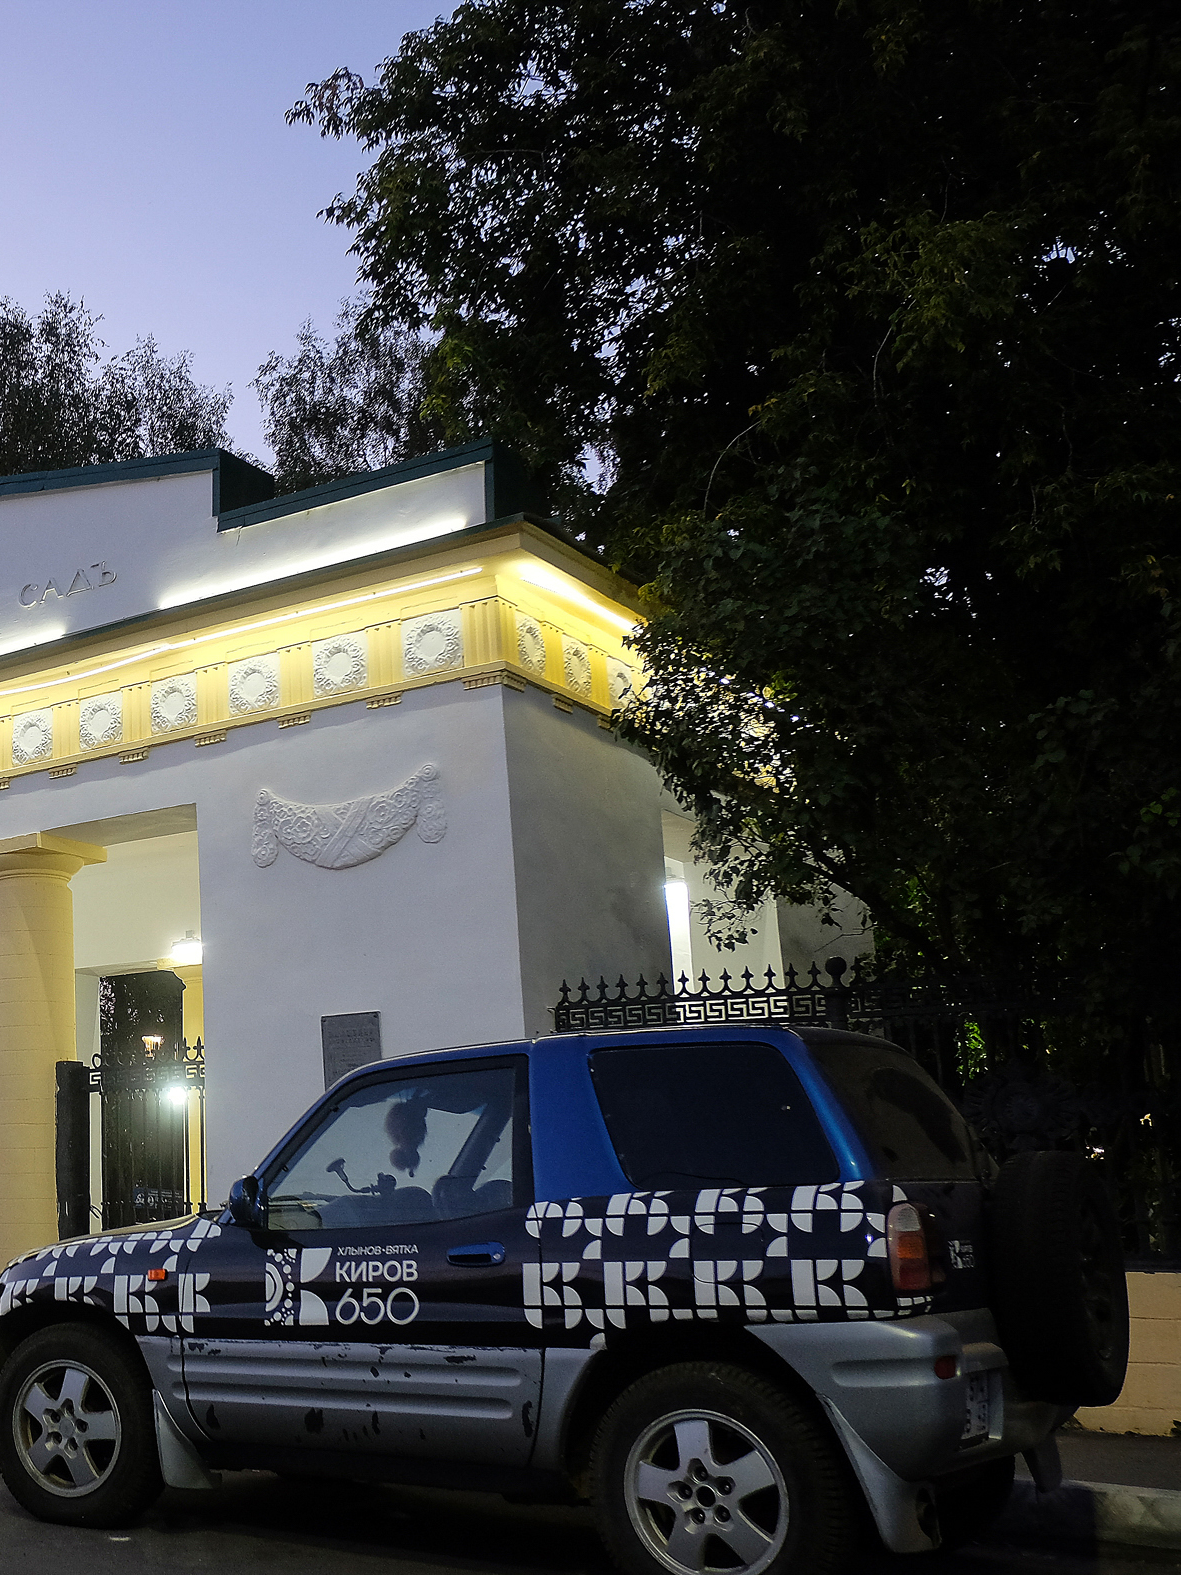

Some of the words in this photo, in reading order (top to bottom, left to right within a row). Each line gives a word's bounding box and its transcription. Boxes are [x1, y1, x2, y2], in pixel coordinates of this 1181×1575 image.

[18, 560, 118, 610] САДЪ
[335, 1259, 419, 1283] КИРОВ
[335, 1286, 420, 1325] 650
